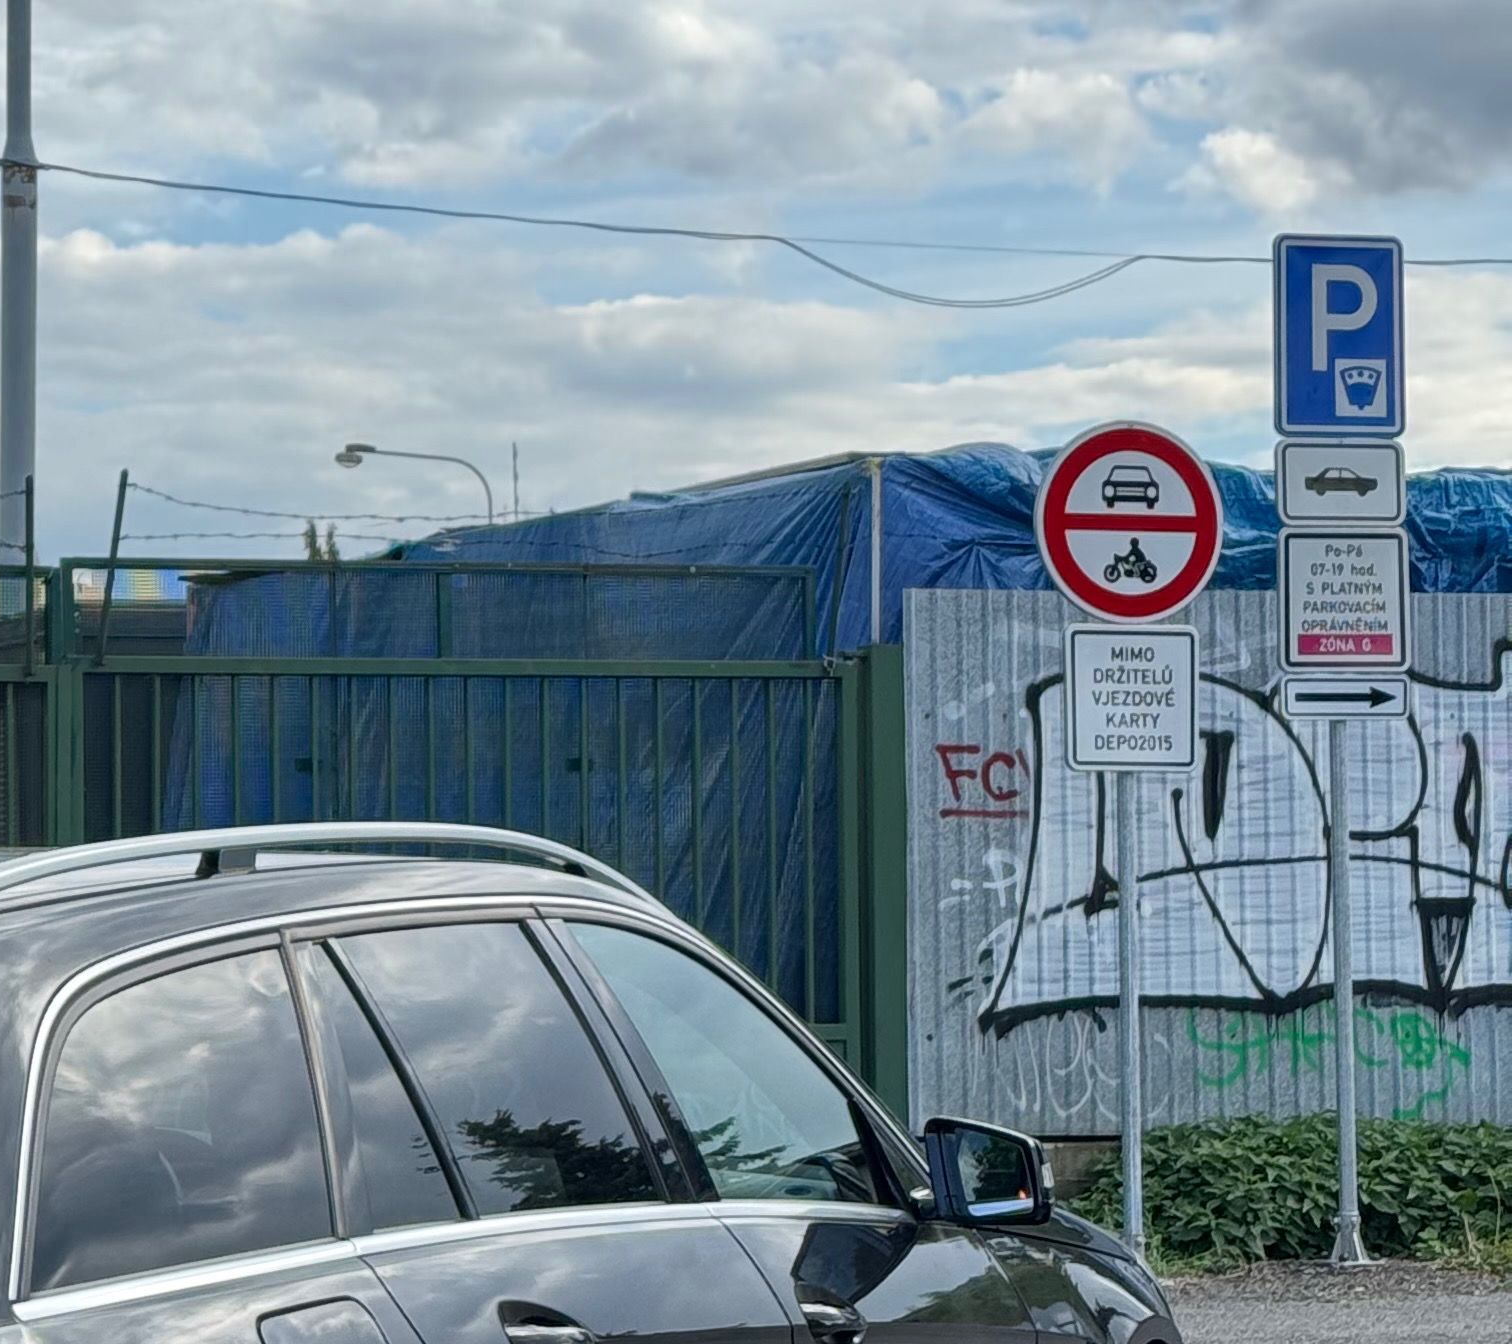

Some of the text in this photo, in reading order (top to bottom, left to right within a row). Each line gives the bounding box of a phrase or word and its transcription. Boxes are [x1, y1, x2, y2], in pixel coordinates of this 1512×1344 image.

[1312, 264, 1378, 371] P
[1311, 563, 1344, 576] 07-19
[1306, 579, 1383, 595] S PLATNÝM
[1303, 598, 1386, 614] PARKOVACÍM
[1301, 616, 1388, 632] OPRÁVNĚNÍM
[1319, 636, 1356, 652] ZÓNA
[1110, 646, 1155, 662] MIMO
[1093, 664, 1173, 685] DRŽITELŮ
[1091, 687, 1176, 707] VJEZDOVÉ
[1105, 712, 1161, 729] KARTY
[1094, 735, 1173, 751] DEPO2015
